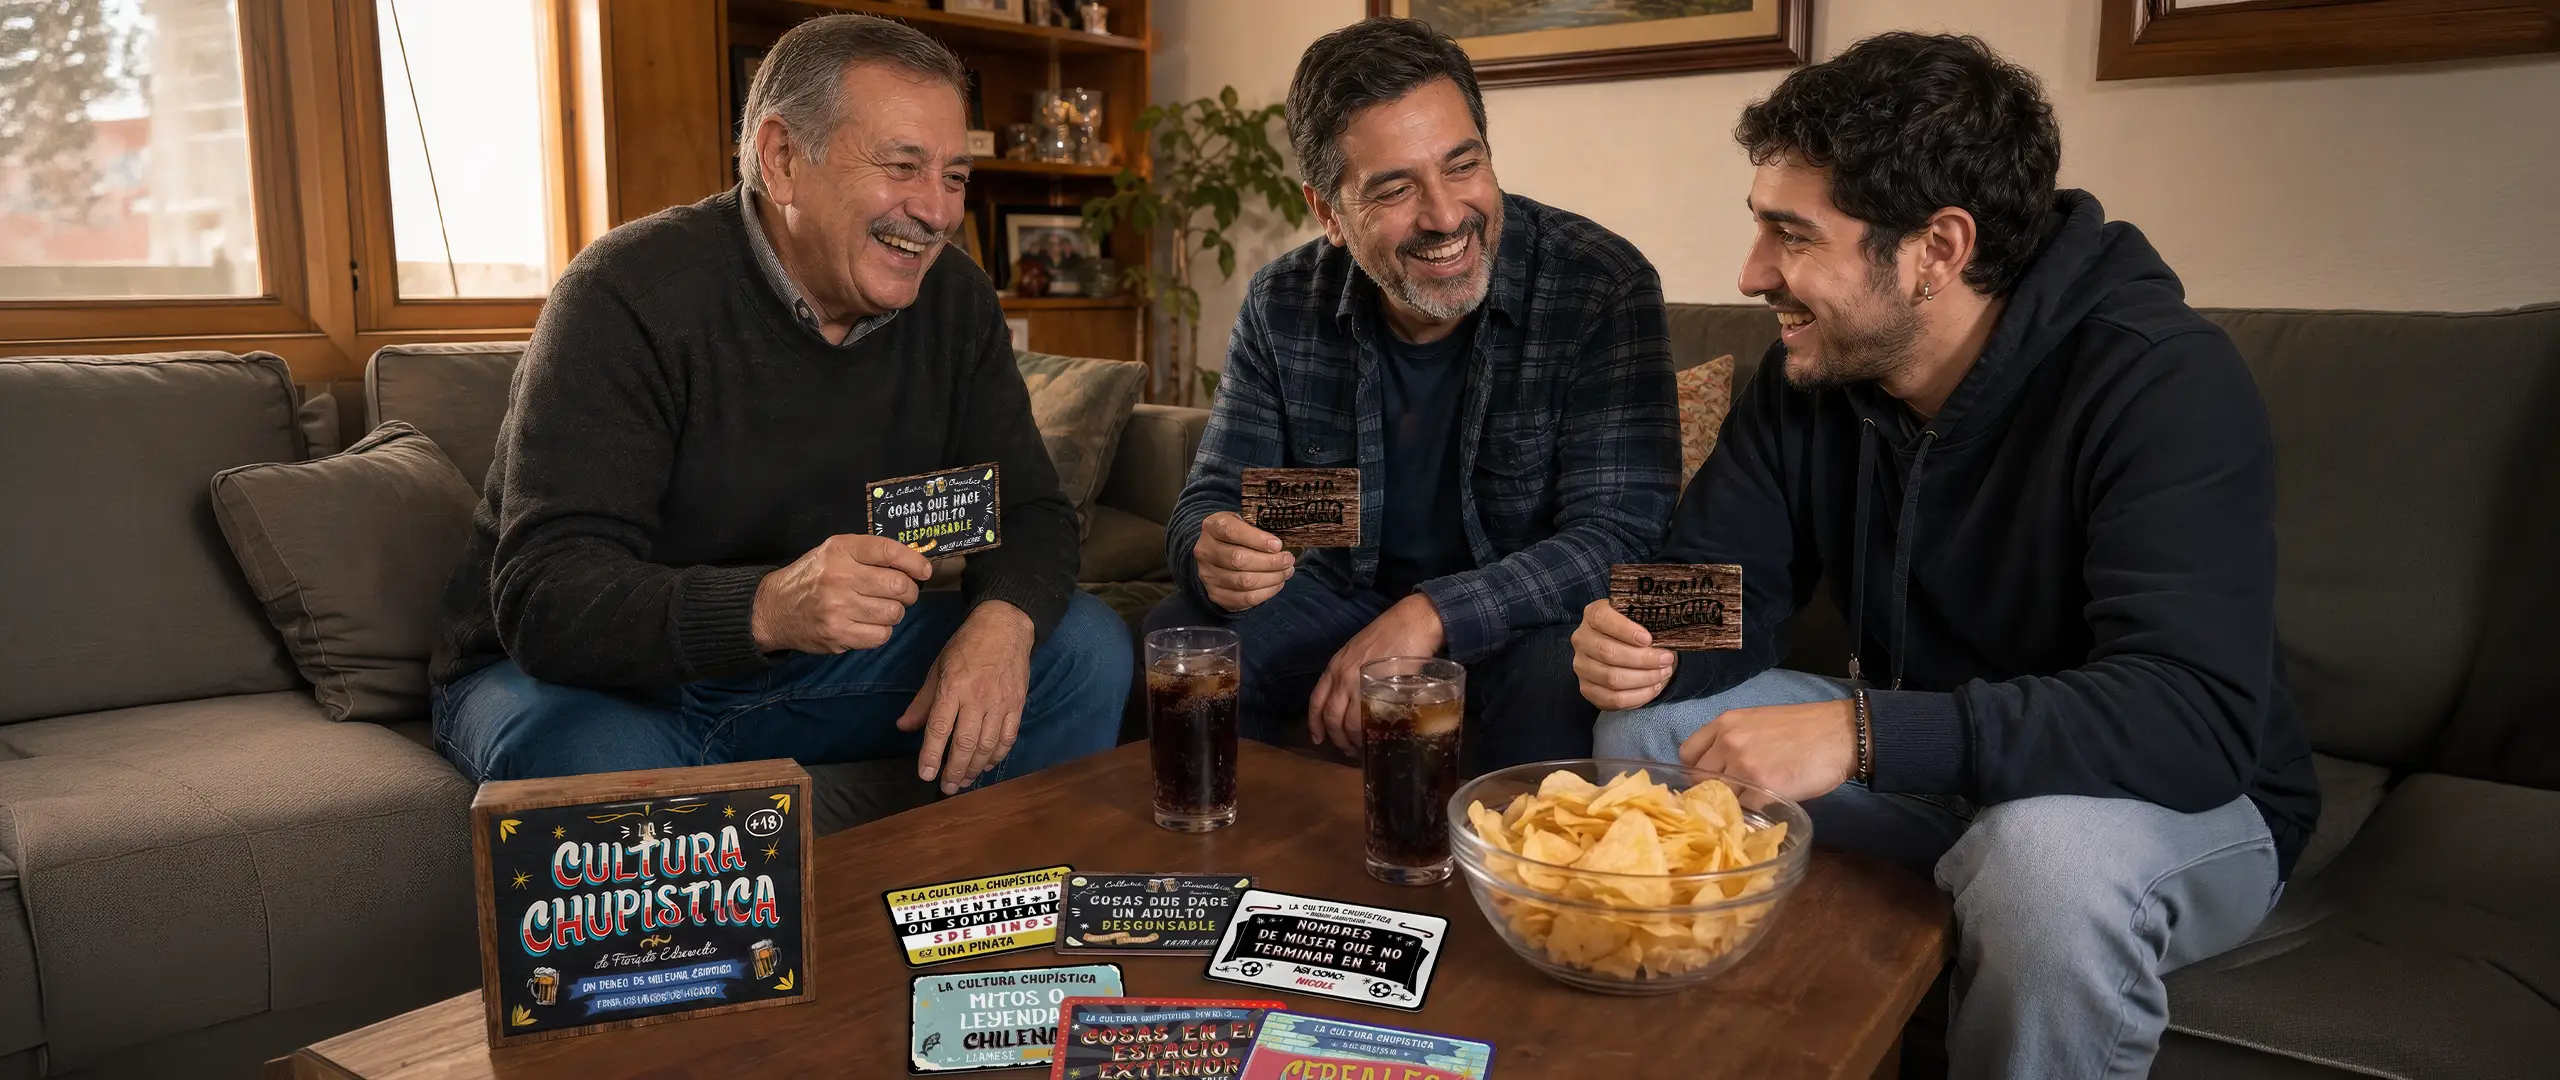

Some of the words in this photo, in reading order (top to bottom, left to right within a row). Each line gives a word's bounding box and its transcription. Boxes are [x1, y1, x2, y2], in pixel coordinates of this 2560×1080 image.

[888, 501, 923, 519] COSAS
[928, 497, 949, 511] QUE
[953, 491, 981, 507] HACE
[905, 515, 919, 529] UN
[924, 507, 966, 526] ADULTO
[898, 518, 973, 542] RESPONSABLE
[750, 811, 778, 831] +18
[551, 825, 747, 890] CULTURA
[911, 891, 926, 902] LA
[928, 882, 981, 898] CULTURA
[986, 871, 1051, 890] CHUPÍSTICA
[1090, 895, 1143, 907] COSAS
[520, 874, 781, 957] CHUPÍSTICA
[1112, 908, 1134, 919] UN
[1141, 908, 1205, 919] ADULTO
[1297, 919, 1372, 940] NOMBRES
[938, 944, 966, 957] UNA
[1254, 942, 1334, 965] TERMINAR
[1341, 955, 1362, 968] EN
[1258, 929, 1278, 941] DE
[1283, 931, 1336, 950] MUJER
[1343, 941, 1374, 957] QUE
[1380, 946, 1403, 960] NO
[938, 982, 954, 993] LA
[957, 975, 1016, 990] CULTURA
[1020, 971, 1097, 985] CHUPÍSTICA
[1295, 976, 1336, 990] NICOLE
[969, 990, 1039, 1009] MITOS
[1048, 988, 1064, 1004] O
[1085, 1014, 1096, 1022] LA
[1099, 1014, 1138, 1023] CULTURA
[1080, 1024, 1169, 1046] COSAS
[1182, 1023, 1217, 1042] EN
[1314, 1024, 1326, 1034] LA
[1329, 1026, 1374, 1041] CULTURA
[1112, 1040, 1230, 1062] ESPACIO
[1098, 1057, 1241, 1080] EXTERIOR
[1279, 1060, 1441, 1080] CEREAL
